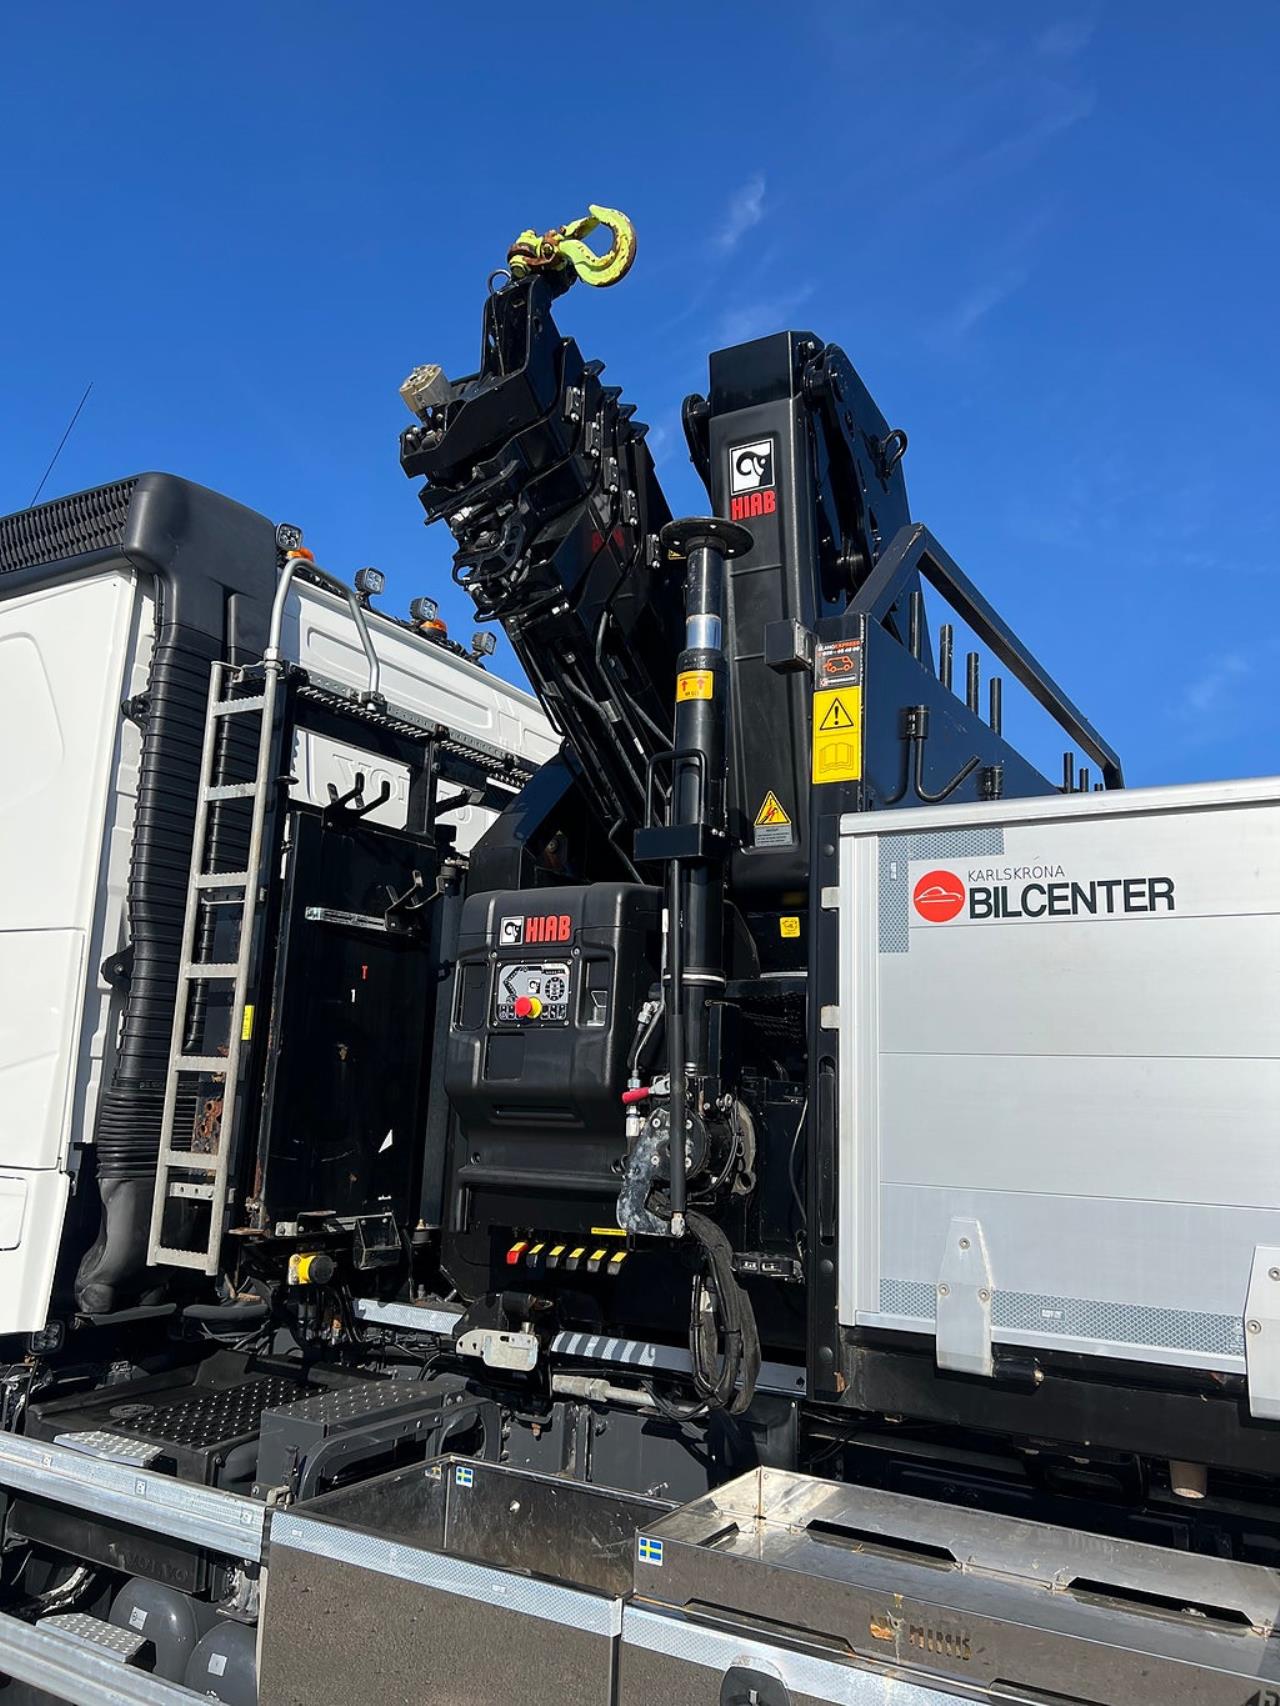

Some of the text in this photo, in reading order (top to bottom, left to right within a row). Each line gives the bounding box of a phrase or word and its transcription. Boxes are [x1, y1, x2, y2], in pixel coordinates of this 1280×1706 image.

[731, 490, 776, 521] HIAB
[968, 864, 1065, 882] KARLSKRONA
[969, 876, 1176, 919] BILCENTER
[525, 915, 571, 943] HIAB
